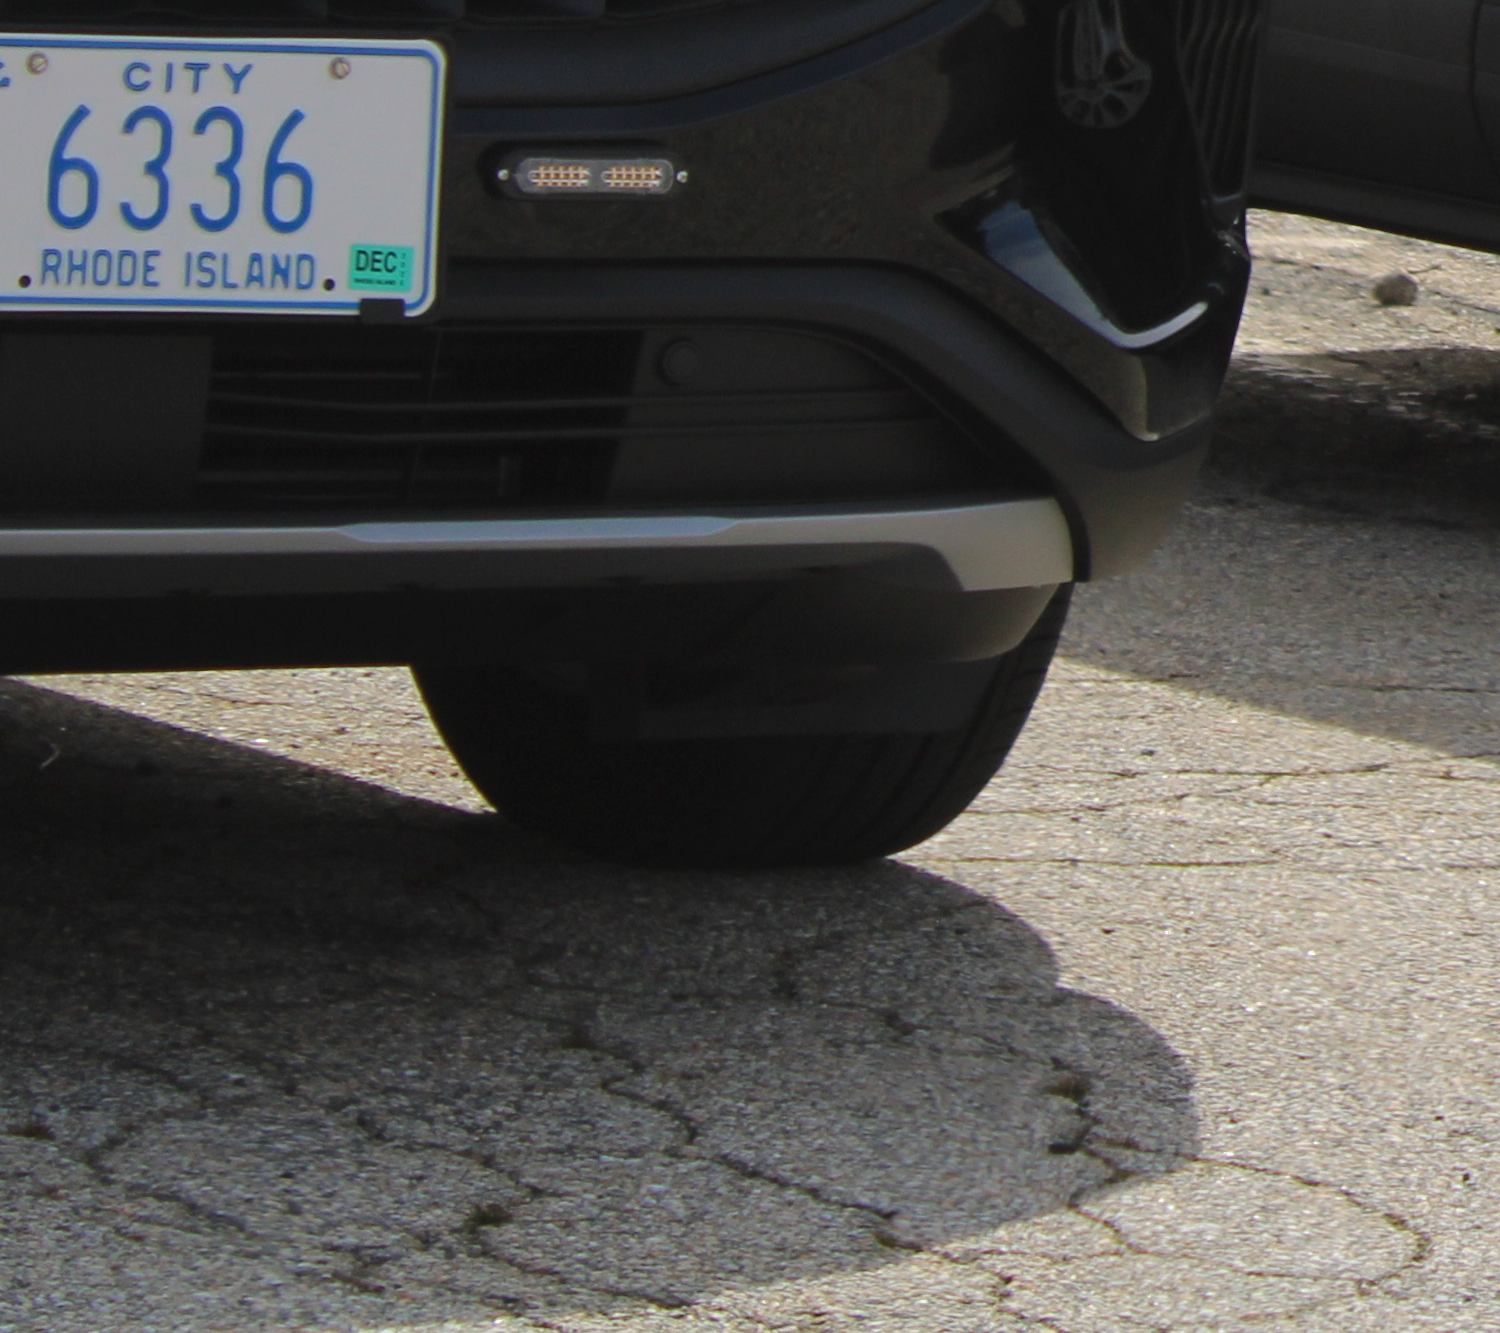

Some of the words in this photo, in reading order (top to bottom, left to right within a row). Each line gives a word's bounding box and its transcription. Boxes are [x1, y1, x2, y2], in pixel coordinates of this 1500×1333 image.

[123, 62, 253, 94] CITY
[47, 104, 314, 234] 6336
[40, 248, 161, 287] RHODE
[185, 250, 316, 290] ISLAND
[355, 250, 397, 274] DEC
